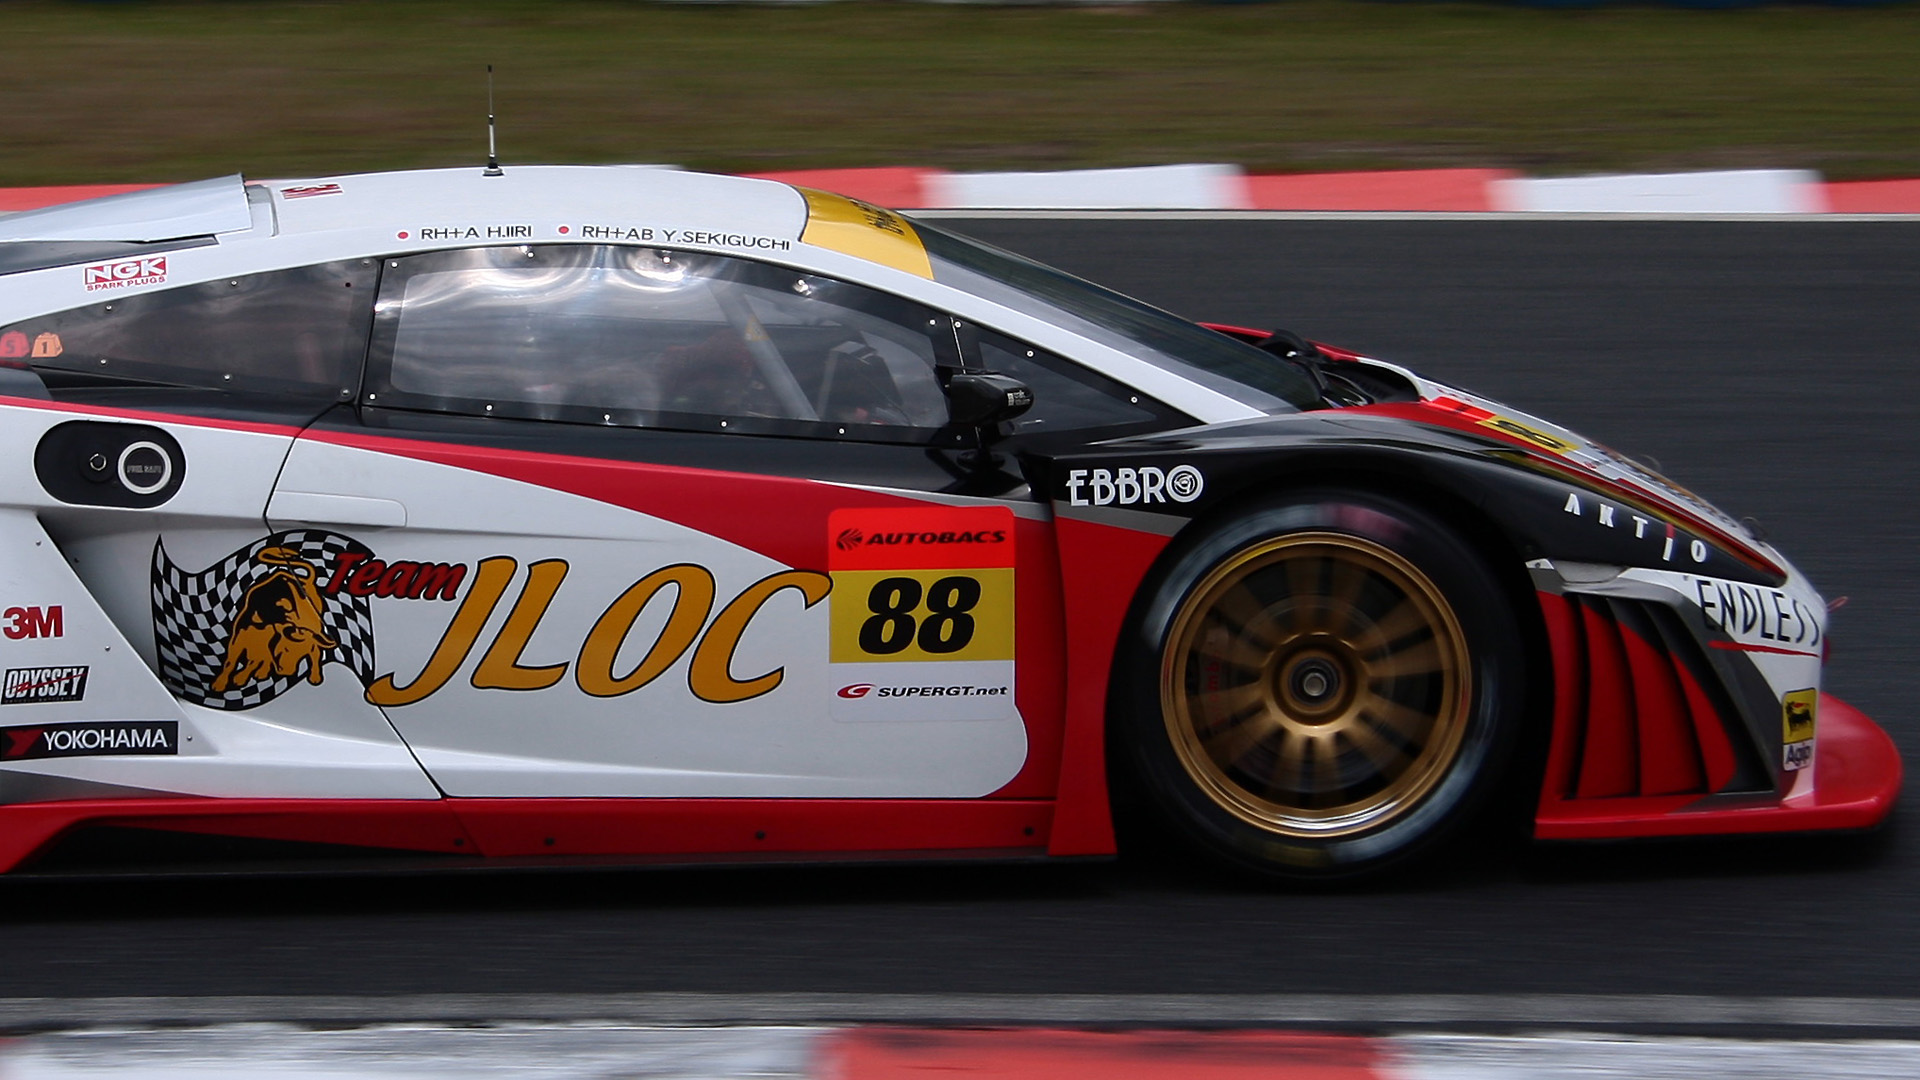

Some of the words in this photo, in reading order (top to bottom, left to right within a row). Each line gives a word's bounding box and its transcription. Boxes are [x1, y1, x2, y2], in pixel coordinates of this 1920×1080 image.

[420, 226, 480, 240] RH+A
[581, 225, 654, 240] RH+AB
[661, 229, 791, 251] Y.SEKIGUCHI
[86, 257, 165, 284] NGK
[87, 281, 124, 292] SPARK
[127, 276, 166, 287] PLUGS
[41, 340, 48, 354] 1
[1065, 464, 1204, 507] EBBRO
[865, 529, 1006, 546] AUTOBACS
[1564, 493, 1708, 564] AKTIO
[326, 552, 468, 600] Team
[2, 605, 64, 640] 3M
[858, 575, 982, 655] 88
[364, 556, 834, 707] JLOC
[4, 666, 85, 699] ODYSSEY
[877, 685, 1008, 698] SUPERGT.net
[43, 728, 168, 751] YOKOHAMA
[1785, 743, 1811, 767] Agip
